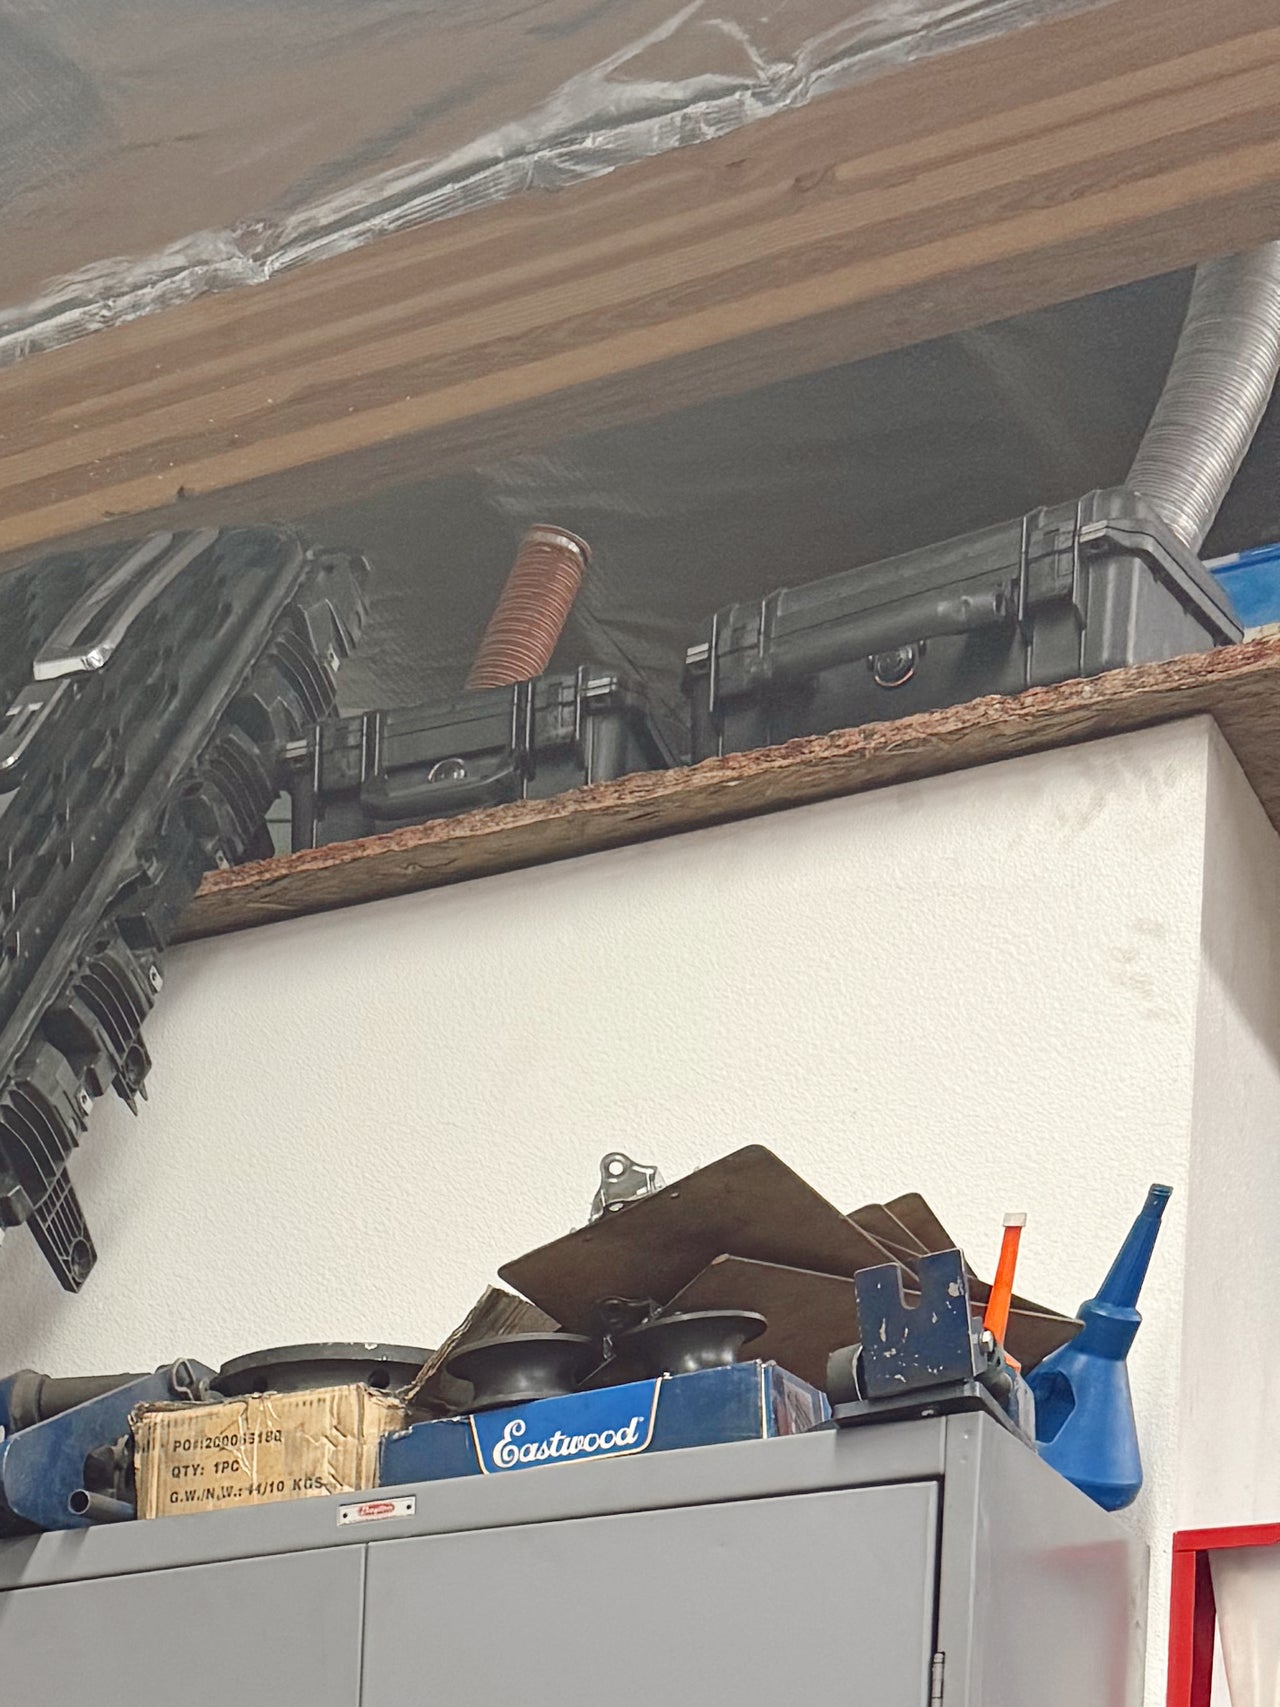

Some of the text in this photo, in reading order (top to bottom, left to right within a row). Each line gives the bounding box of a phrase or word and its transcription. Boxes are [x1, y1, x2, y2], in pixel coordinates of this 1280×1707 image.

[493, 1416, 642, 1468] Eastwood
[171, 1459, 240, 1479] QTY: 1PC
[292, 1476, 324, 1490] KGS
